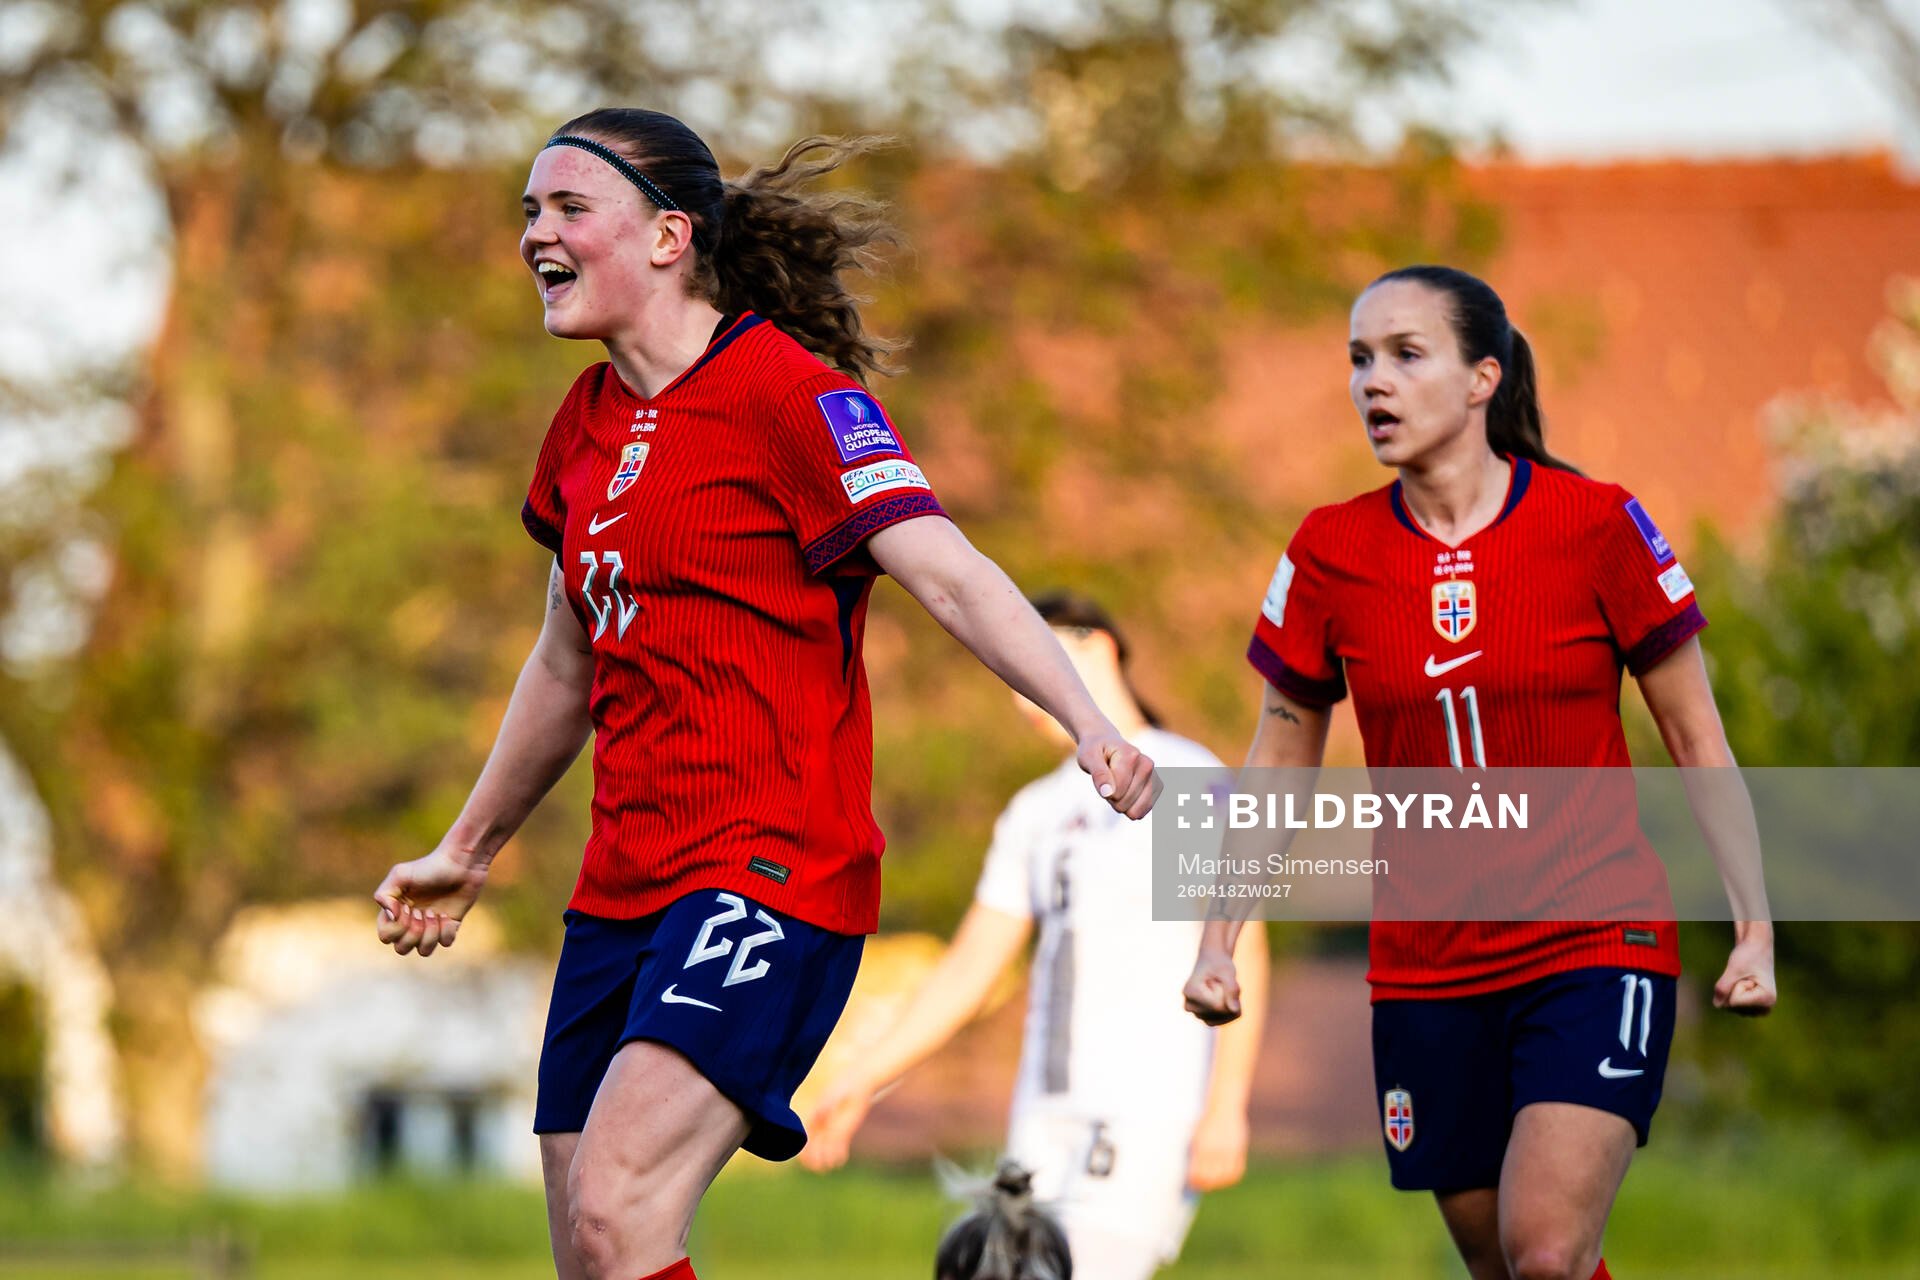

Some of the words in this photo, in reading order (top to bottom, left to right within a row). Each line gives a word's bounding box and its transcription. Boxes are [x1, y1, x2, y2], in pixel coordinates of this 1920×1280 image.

[843, 429, 891, 443] EUROPEAN
[846, 436, 896, 451] QUALIFIERS
[580, 551, 639, 643] 22
[1435, 685, 1487, 774] 11
[683, 892, 785, 988] 22
[1618, 973, 1653, 1058] 11
